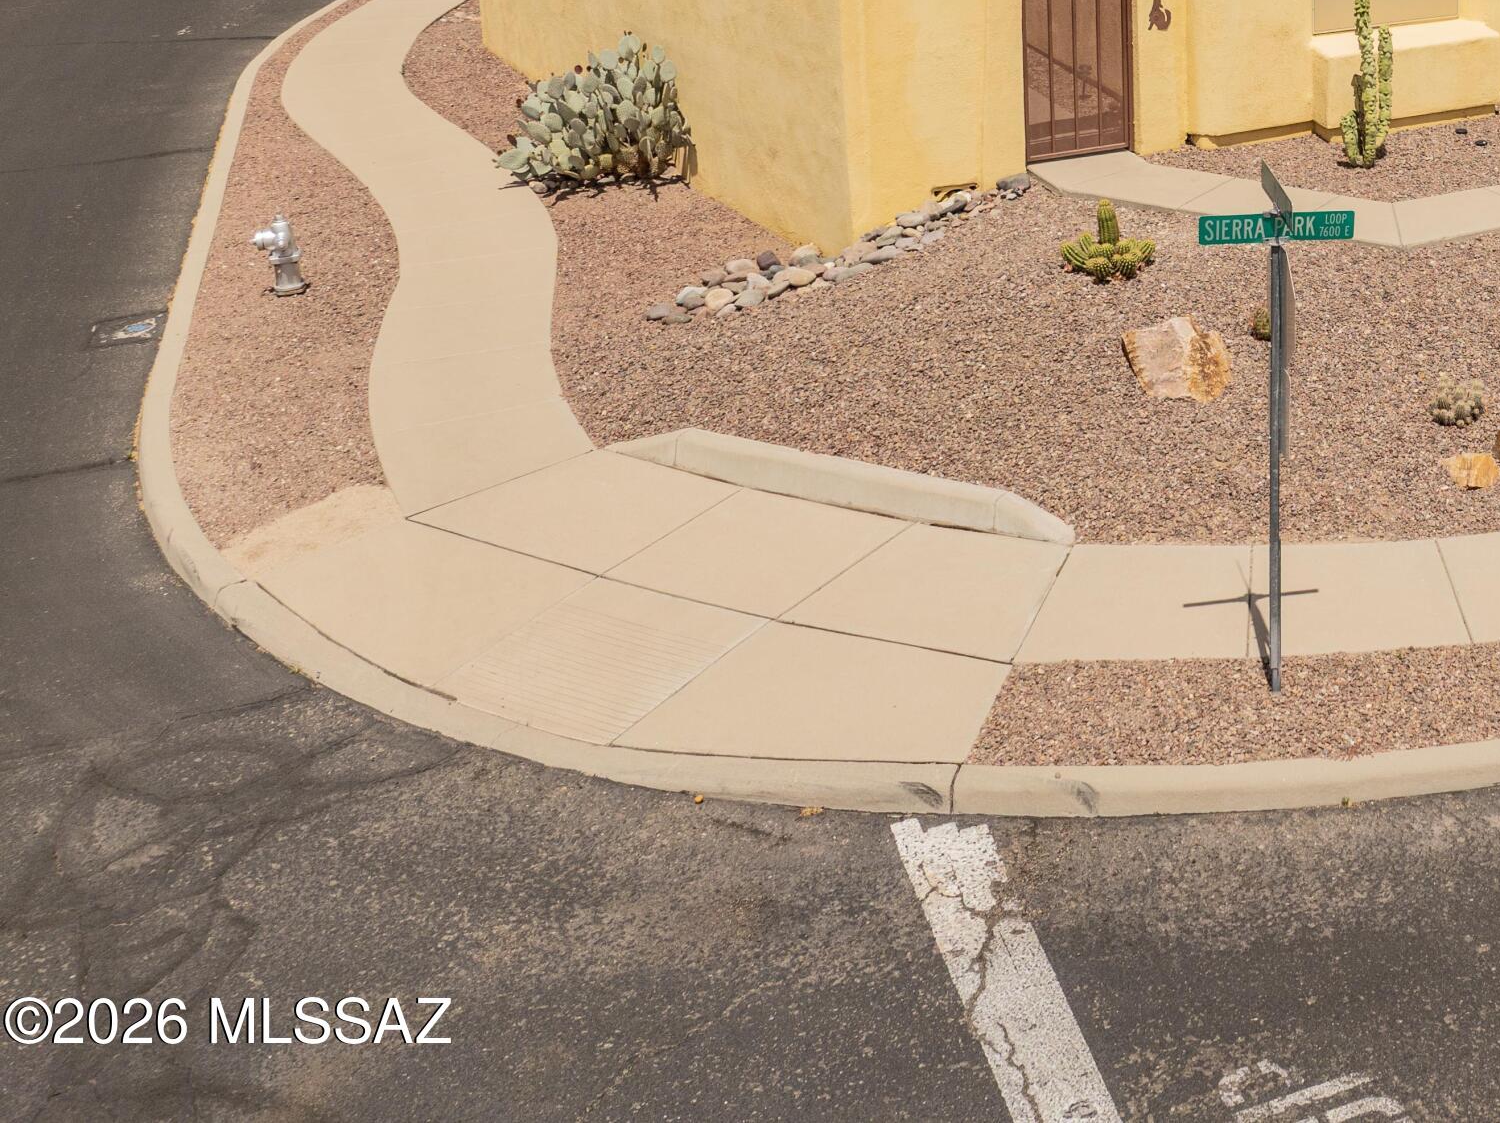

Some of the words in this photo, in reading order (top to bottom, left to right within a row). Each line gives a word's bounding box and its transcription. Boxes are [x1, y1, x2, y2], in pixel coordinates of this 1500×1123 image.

[1325, 213, 1347, 225] LOOP
[1204, 218, 1265, 241] SIERRA
[1319, 225, 1341, 237] 7600
[1344, 225, 1350, 236] E
